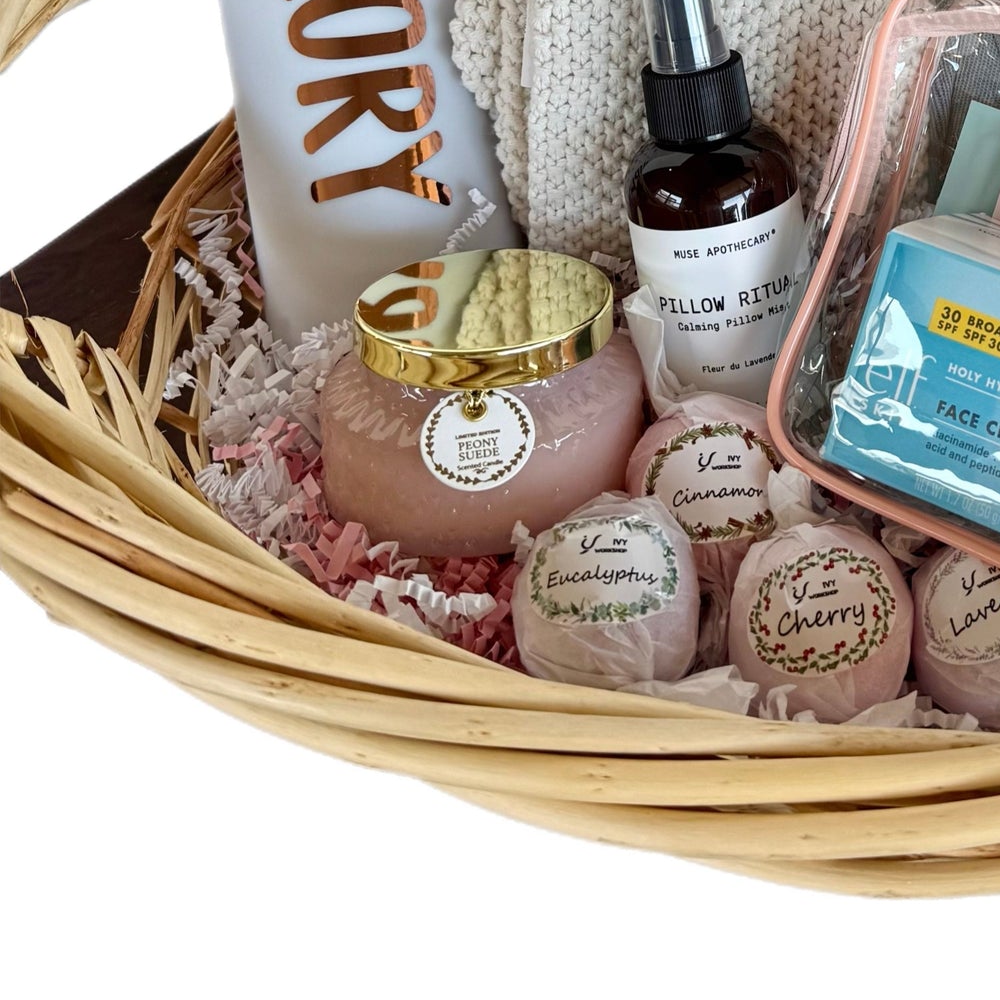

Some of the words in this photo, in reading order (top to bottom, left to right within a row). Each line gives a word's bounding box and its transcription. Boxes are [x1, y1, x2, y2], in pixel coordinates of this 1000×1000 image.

[674, 249, 699, 259] MUSE
[659, 296, 725, 314] PILLOW
[941, 306, 961, 323] 30
[678, 321, 720, 332] Calming
[726, 312, 763, 328] Pillow
[937, 320, 958, 334] SPF
[963, 328, 987, 345] SPF
[702, 365, 725, 373] Fleur
[730, 362, 740, 370] du
[947, 362, 982, 384] HOLY
[936, 400, 980, 429] FACE
[458, 437, 499, 451] PEONY
[925, 441, 946, 456] acid
[948, 450, 968, 465] and
[458, 447, 500, 461] SUEDE
[547, 564, 659, 589] Eucalyptus
[822, 579, 836, 588] IVY
[778, 602, 865, 637] Cherry
